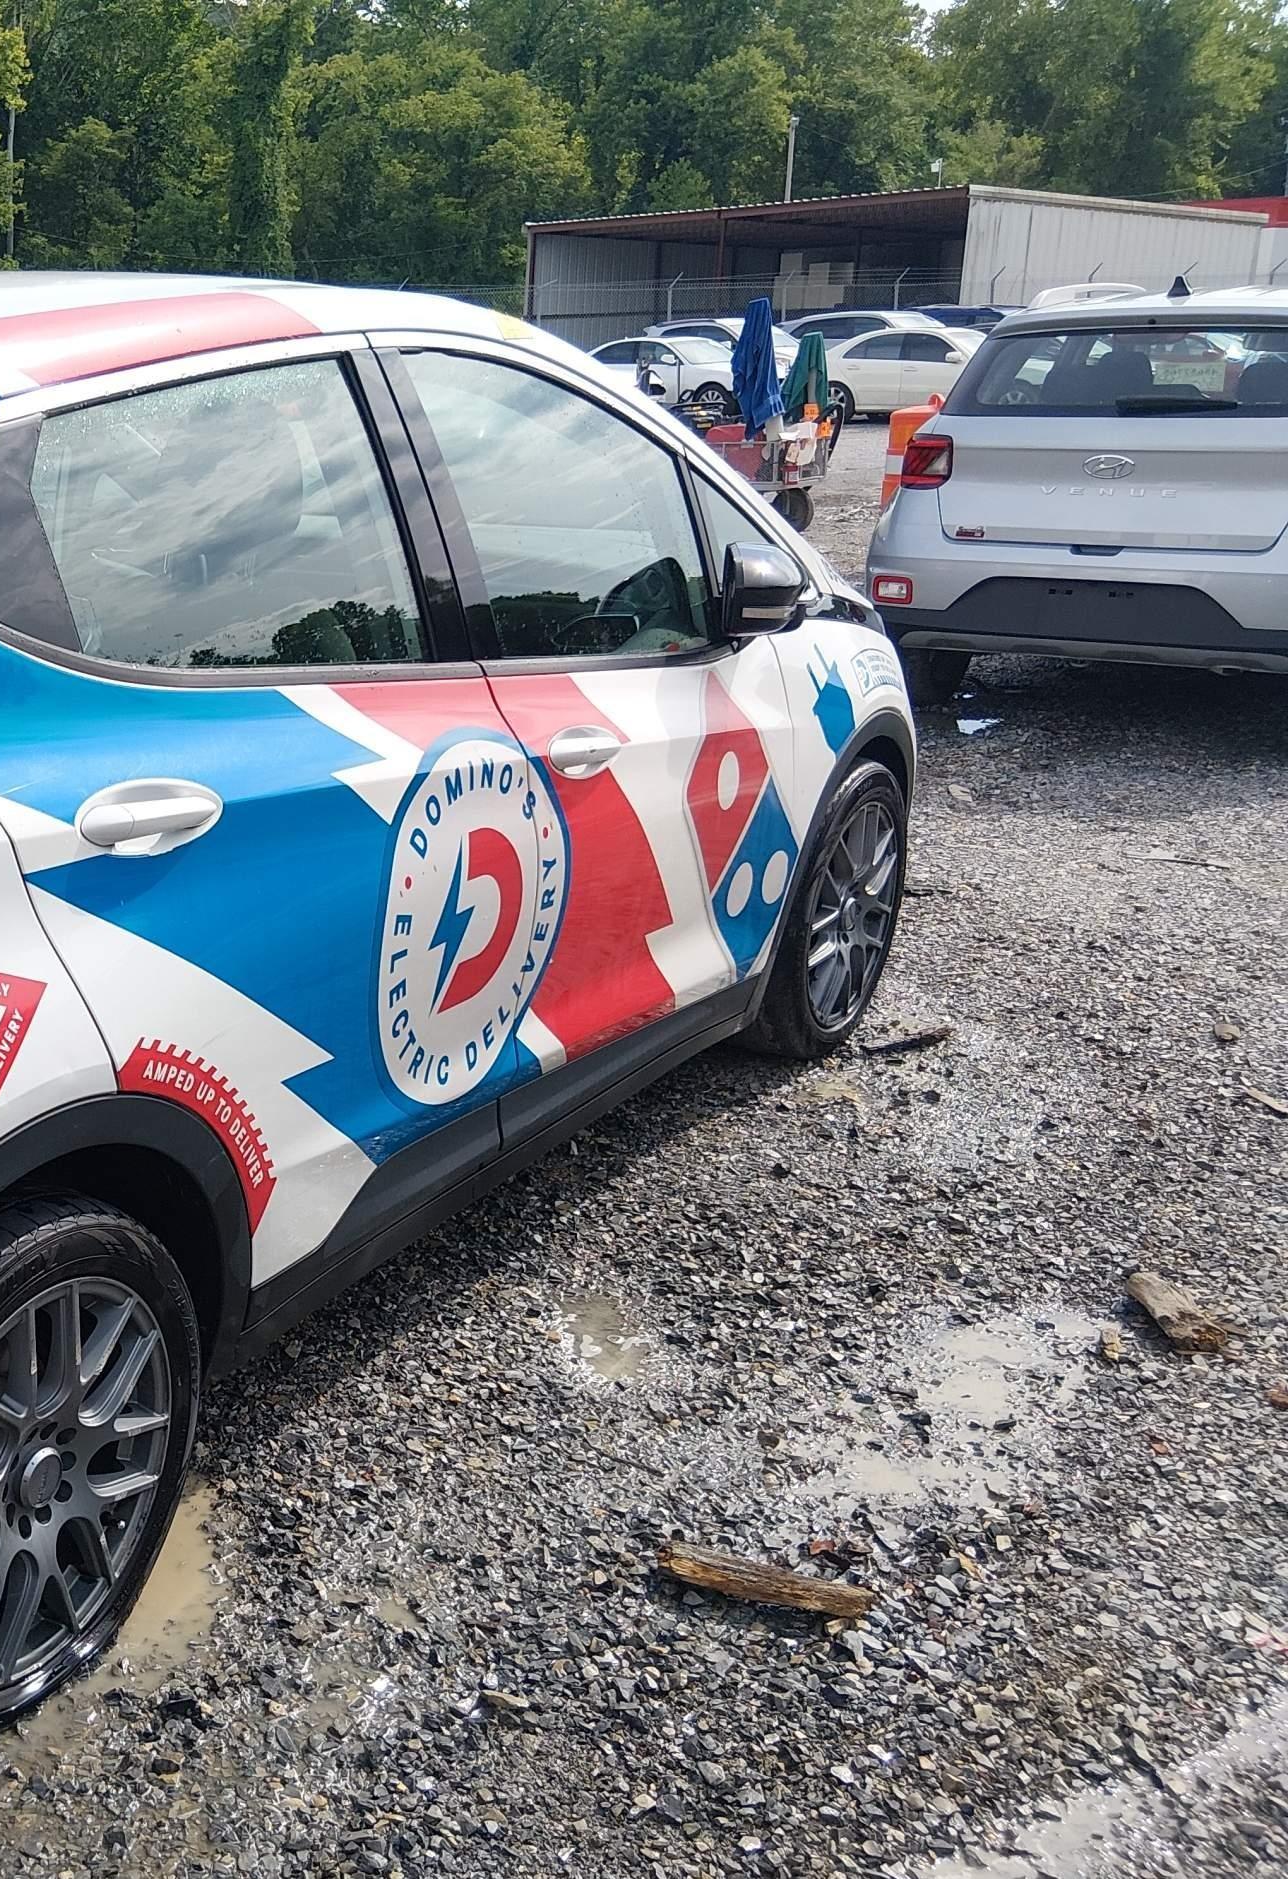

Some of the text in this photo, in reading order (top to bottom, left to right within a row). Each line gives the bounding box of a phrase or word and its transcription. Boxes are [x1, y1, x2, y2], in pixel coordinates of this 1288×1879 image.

[1040, 485, 1177, 498] VENUE
[409, 757, 537, 860] DOMINO'S
[388, 857, 558, 1086] ELECTRIC DELIVERY
[143, 1060, 264, 1189] AMPED UP TO DELIVER
